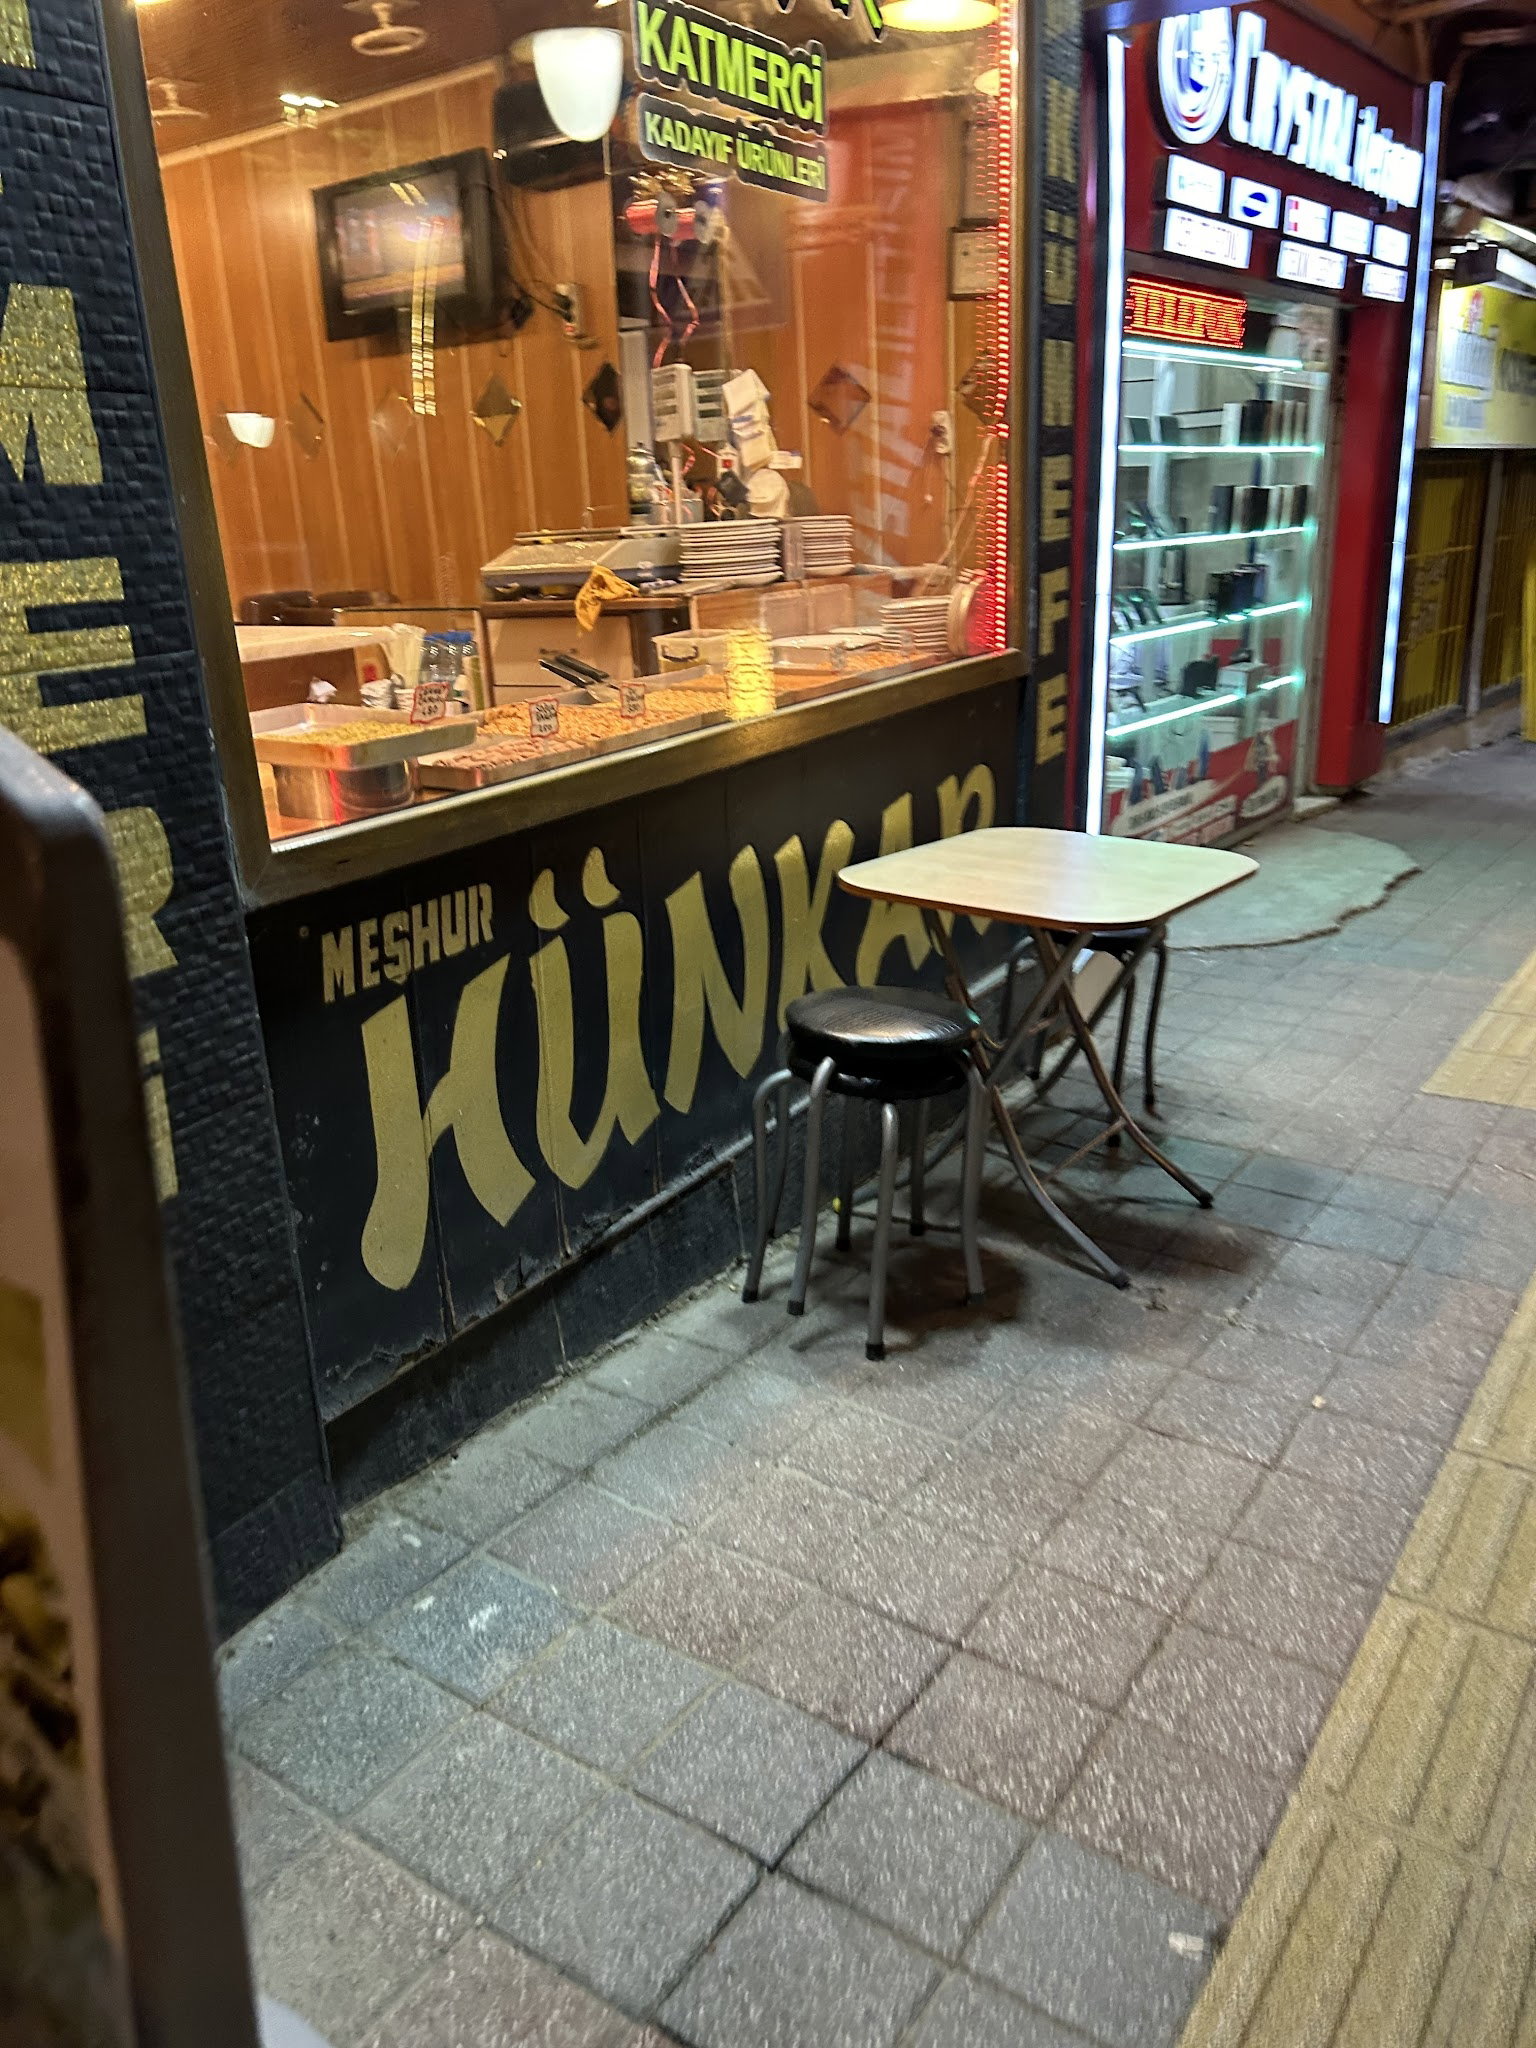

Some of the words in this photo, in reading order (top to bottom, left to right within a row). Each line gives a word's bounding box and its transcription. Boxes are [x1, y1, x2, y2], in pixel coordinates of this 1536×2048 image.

[637, 1, 824, 124] KATMERCİ
[644, 111, 733, 164] KADAYIF
[736, 132, 826, 190] ÜRÜNLERİ
